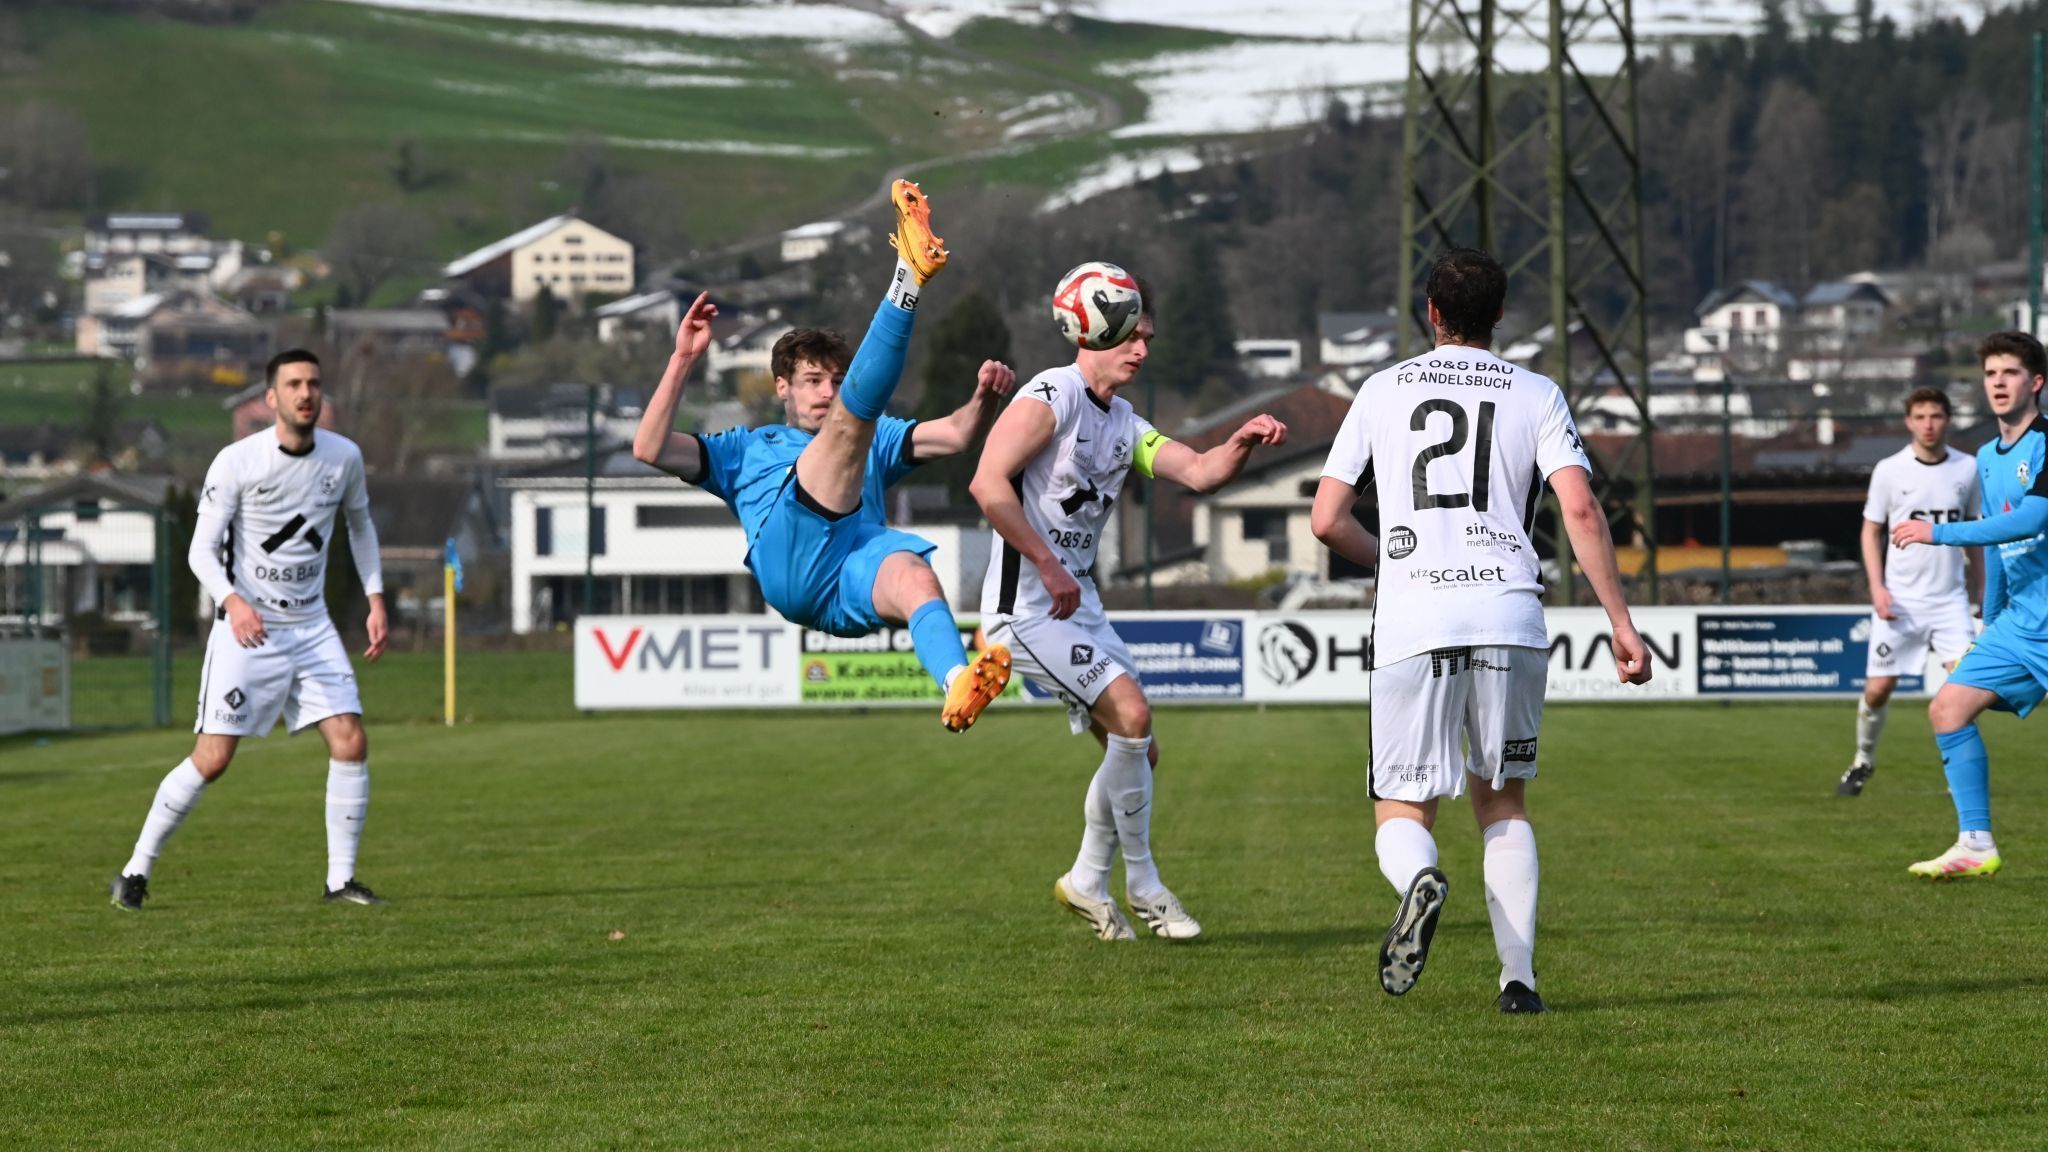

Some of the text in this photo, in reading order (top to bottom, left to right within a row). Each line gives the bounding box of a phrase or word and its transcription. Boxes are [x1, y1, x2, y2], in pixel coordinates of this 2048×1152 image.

[1429, 360, 1514, 375] O&S BAU
[1397, 371, 1512, 390] FC ANDELSBUCH
[1410, 398, 1495, 512] 21
[255, 566, 292, 582] O&S
[1429, 565, 1506, 584] scalet
[592, 627, 784, 672] VMET
[1077, 656, 1113, 689] Egger
